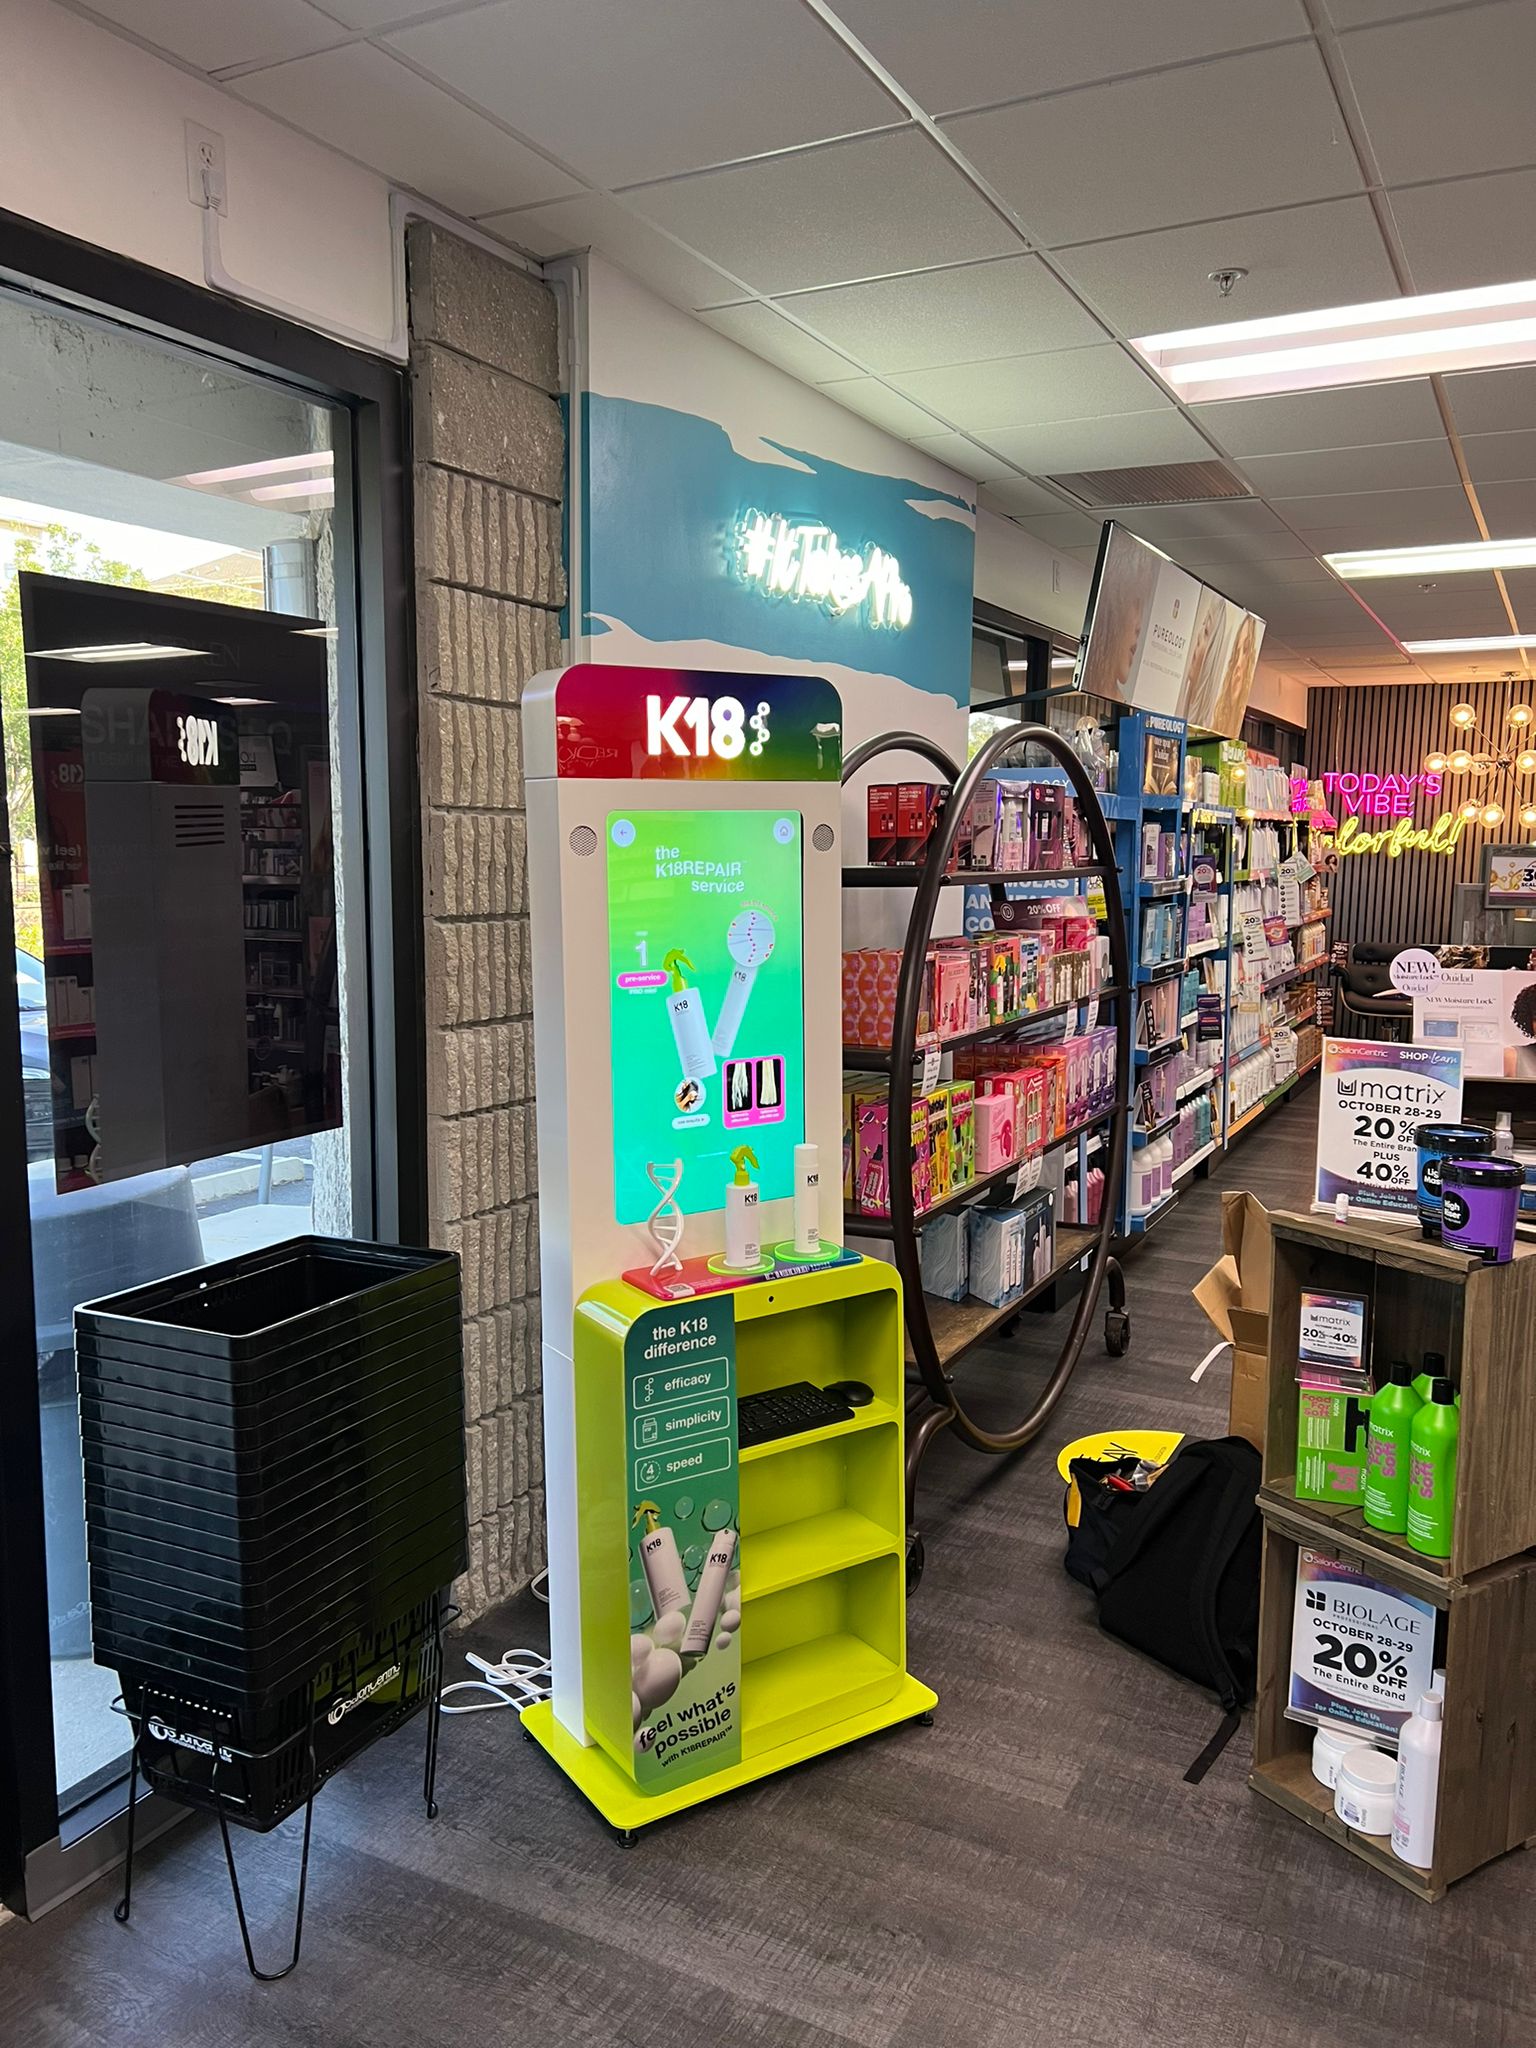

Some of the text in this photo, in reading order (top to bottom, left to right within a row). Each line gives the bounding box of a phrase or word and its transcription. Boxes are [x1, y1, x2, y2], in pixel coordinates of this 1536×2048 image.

[1153, 624, 1186, 648] PUREOLOGY
[647, 695, 746, 760] K18
[1150, 716, 1185, 733] PUREOLOGY
[1324, 773, 1442, 796] TODAY'S
[656, 846, 680, 859] the
[691, 879, 745, 894] service
[1046, 903, 1061, 914] OFF
[635, 940, 648, 968] 1
[1397, 961, 1436, 974] NEW!
[1441, 972, 1474, 983] Ouidad
[1426, 996, 1443, 1004] NEW
[1444, 997, 1475, 1005] Moisture
[1338, 1045, 1389, 1058] SalonCentric
[1400, 1051, 1428, 1061] SHOP
[1360, 1083, 1447, 1105] matrix
[1339, 1099, 1442, 1119] OCTOBER 28-29
[1353, 1138, 1417, 1153] The Entire Bran
[1398, 1135, 1414, 1144] OF
[1373, 1151, 1400, 1162] PLUS
[1356, 1161, 1409, 1182] 40%
[1391, 1177, 1411, 1186] OFF
[1355, 1194, 1382, 1205] Online
[1383, 1199, 1418, 1210] Educatio
[652, 1317, 708, 1341] the K18
[1318, 1315, 1351, 1326] matrix
[644, 1334, 717, 1360] difference
[664, 1372, 711, 1391] efficacy
[665, 1409, 722, 1432] simplicity
[646, 1453, 704, 1476] 4 speed
[646, 1538, 662, 1553] K18
[709, 1552, 728, 1565] K18
[1332, 1613, 1379, 1630] PROFESSIONAL
[1333, 1599, 1421, 1636] BIOLAGE
[1312, 1617, 1413, 1653] OCTOBER 28-29
[1313, 1634, 1408, 1679] 20%
[1313, 1666, 1332, 1680] The
[1336, 1675, 1369, 1691] Entire
[1372, 1685, 1406, 1702] Brand
[1376, 1673, 1408, 1690] OFF
[639, 1680, 737, 1750] feel what's
[1314, 1702, 1399, 1733] for Online Education!
[1330, 1701, 1381, 1722] Plus, Join Us
[654, 1706, 732, 1759] possible
[660, 1751, 680, 1768] with
